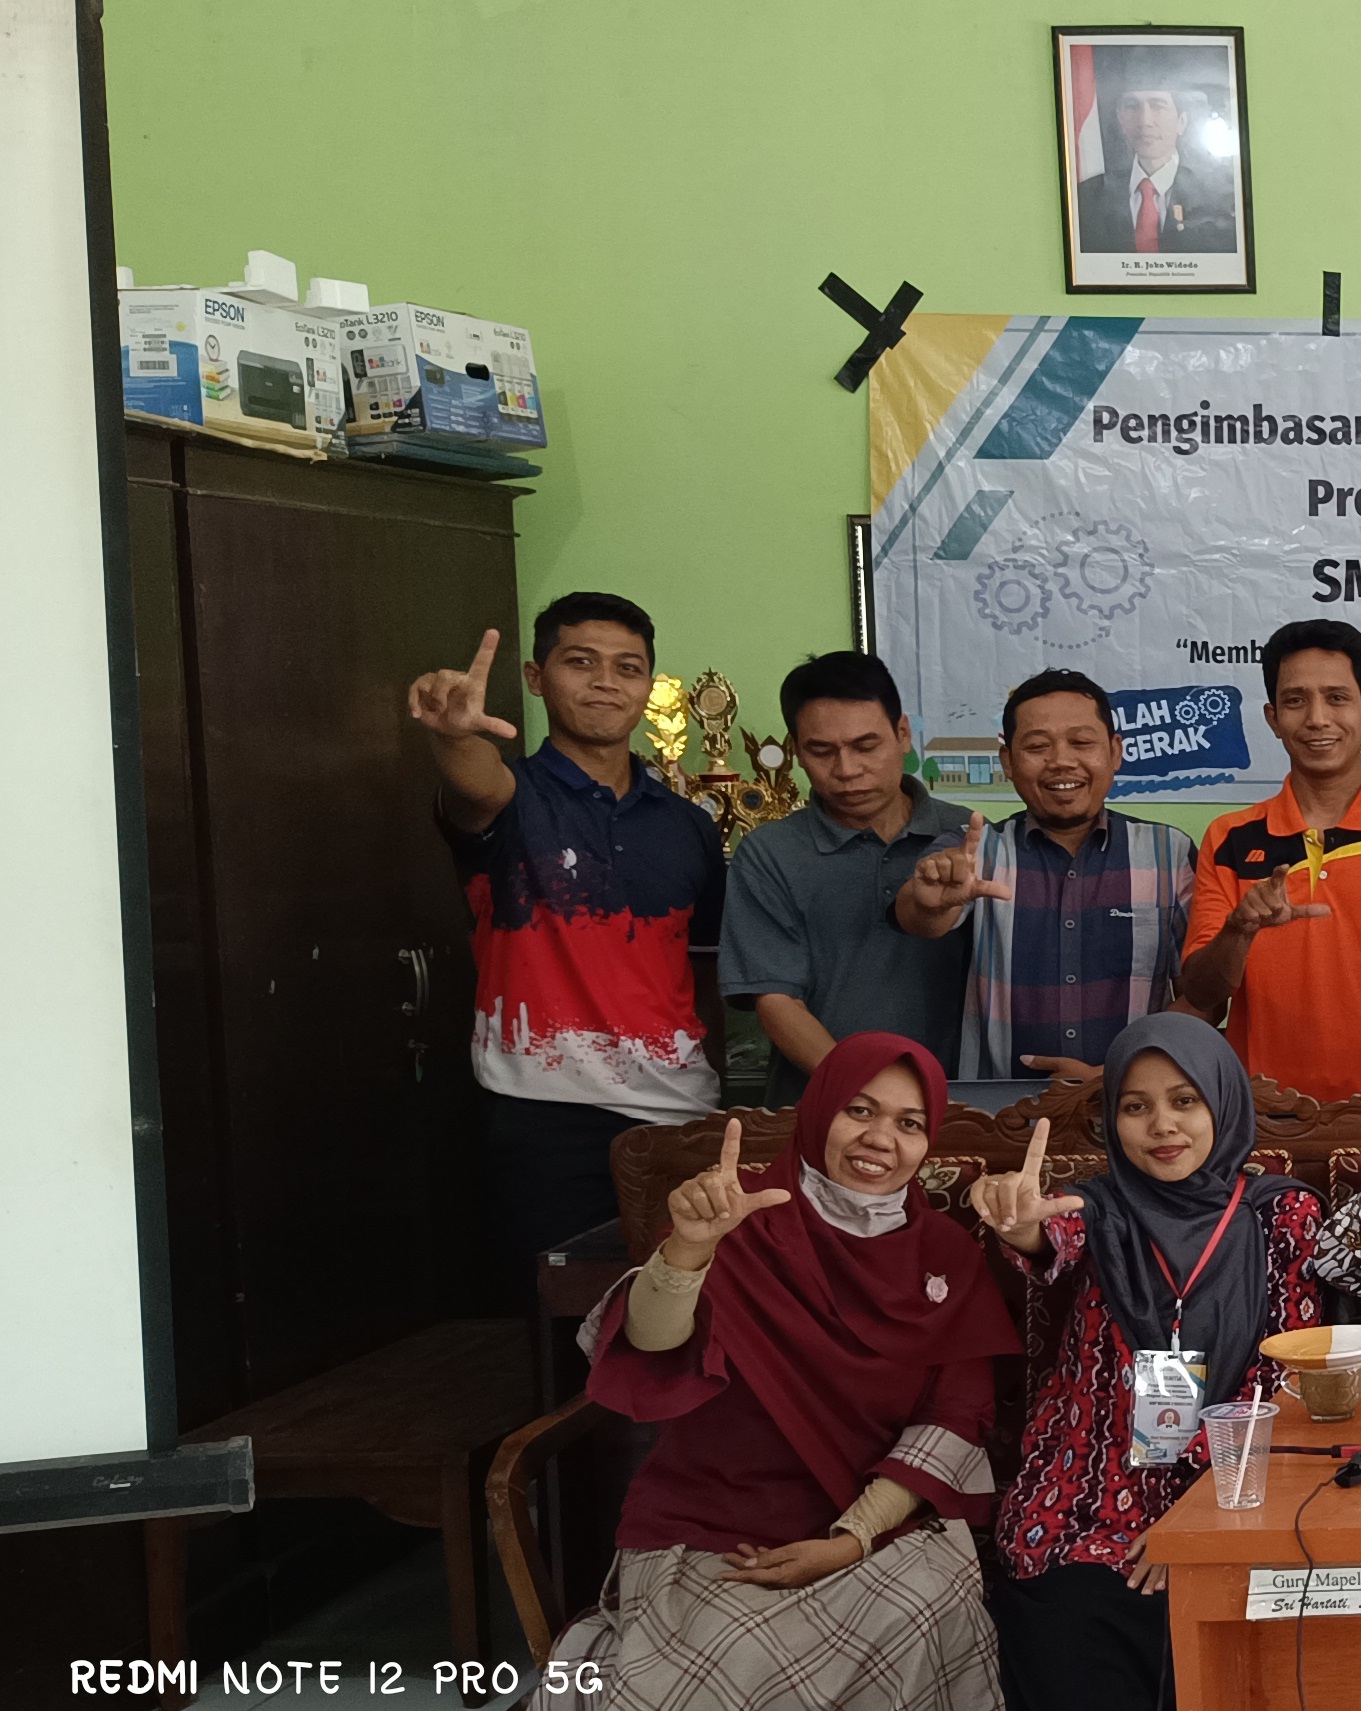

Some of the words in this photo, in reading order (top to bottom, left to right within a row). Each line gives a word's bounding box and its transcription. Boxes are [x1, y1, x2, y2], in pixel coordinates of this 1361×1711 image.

[1165, 261, 1198, 269] Widodo
[204, 298, 245, 323] EPSON
[366, 311, 399, 325] L3210
[414, 310, 445, 328] EPSON
[1175, 638, 1263, 664] “Memb
[1122, 725, 1211, 763] GERAK
[1272, 1574, 1309, 1589] Guru
[1315, 1571, 1361, 1591] Mapel
[1271, 1597, 1295, 1613] Sri
